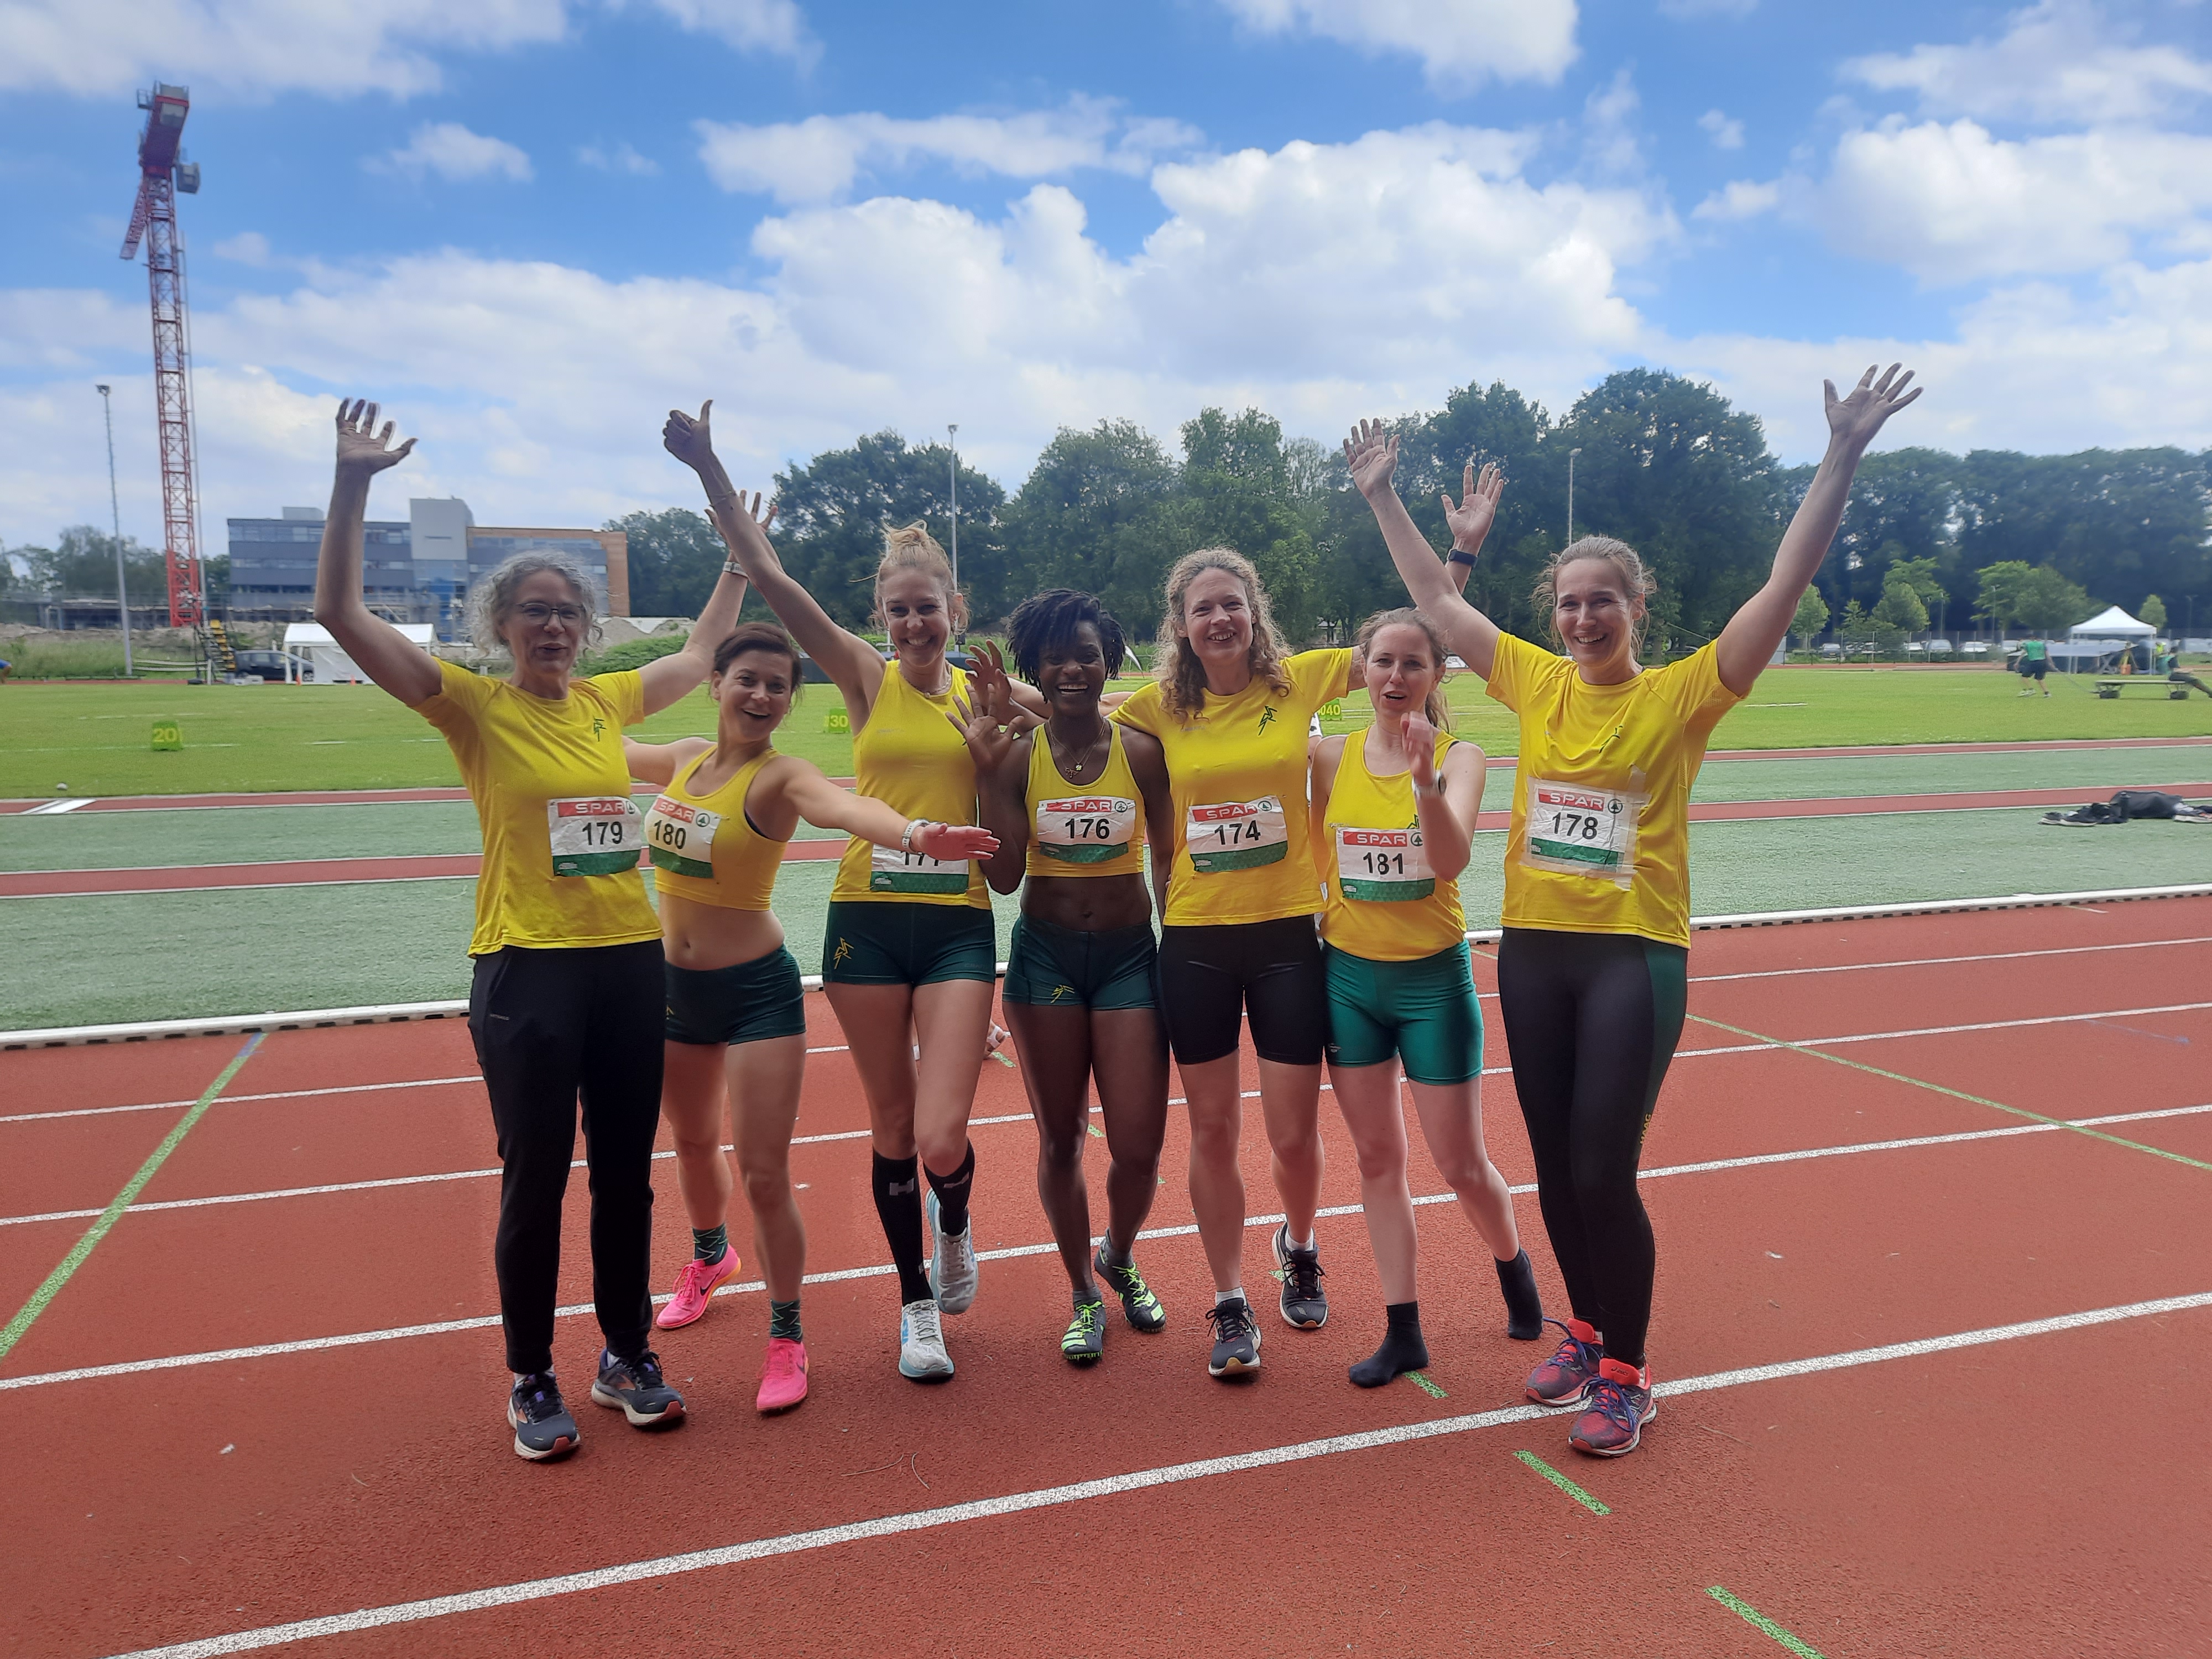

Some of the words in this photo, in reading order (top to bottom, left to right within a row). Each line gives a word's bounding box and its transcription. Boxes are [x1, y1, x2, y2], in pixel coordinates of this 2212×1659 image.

[1326, 704, 1340, 716] 40
[830, 715, 848, 727] 30
[153, 728, 176, 742] 20
[575, 800, 624, 814] SPAR
[1061, 801, 1111, 811] SPAR
[1550, 792, 1604, 808] SPAR
[658, 801, 694, 822] SPAR
[1206, 805, 1257, 819] SPAR
[582, 821, 623, 846] 179
[1065, 818, 1110, 839] 176
[1214, 820, 1261, 846] 174
[1552, 812, 1599, 840] 178
[653, 819, 687, 850] 180
[1357, 833, 1406, 844] SPAR
[1363, 852, 1404, 875] 181
